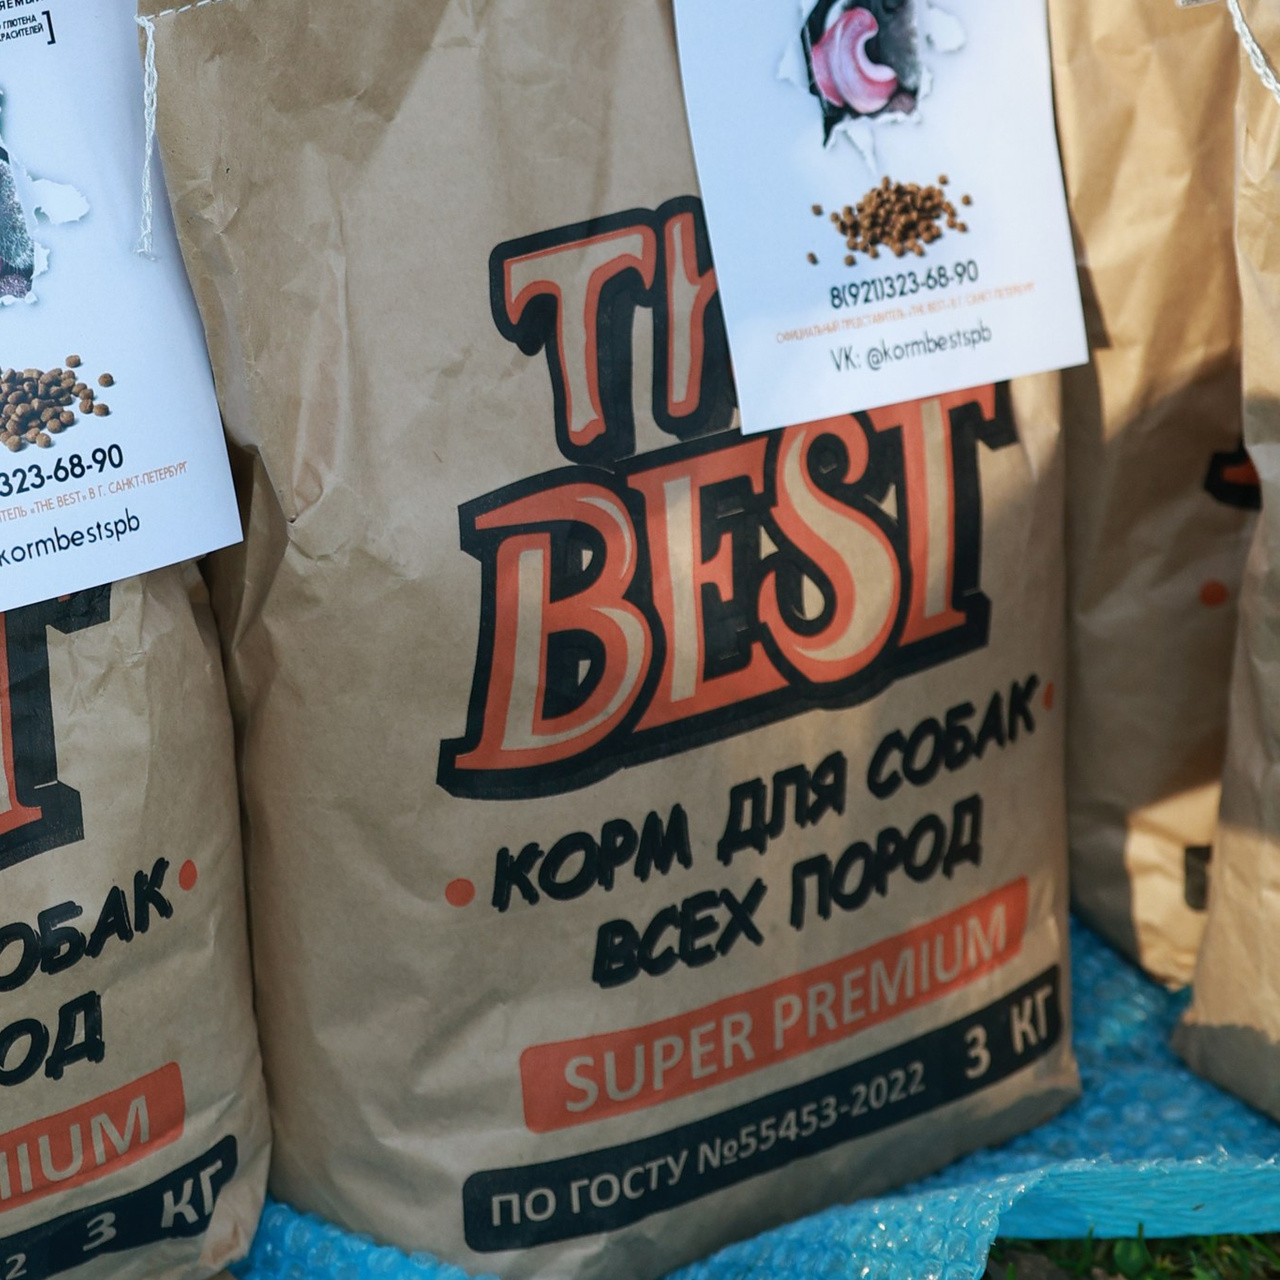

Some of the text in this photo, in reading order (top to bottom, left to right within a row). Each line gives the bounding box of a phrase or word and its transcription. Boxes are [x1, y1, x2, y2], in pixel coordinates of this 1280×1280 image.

[830, 259, 980, 310] 8(921)323-68-90
[830, 317, 993, 372] VK: @kormbestspb
[108, 461, 188, 495] САНКТ-ПЕТЕРБУРГ
[437, 382, 1038, 801] BEST
[491, 673, 1041, 913] КОРМ ДЛЯ СОБАК
[591, 795, 984, 988] ВСЕХ ПОРОД
[490, 982, 1055, 1227] ПО ГОСТУ №55453-2022 3 КГ
[563, 901, 1011, 1115] SUPER PREMIUM
[82, 1158, 224, 1253] 3 КГ
